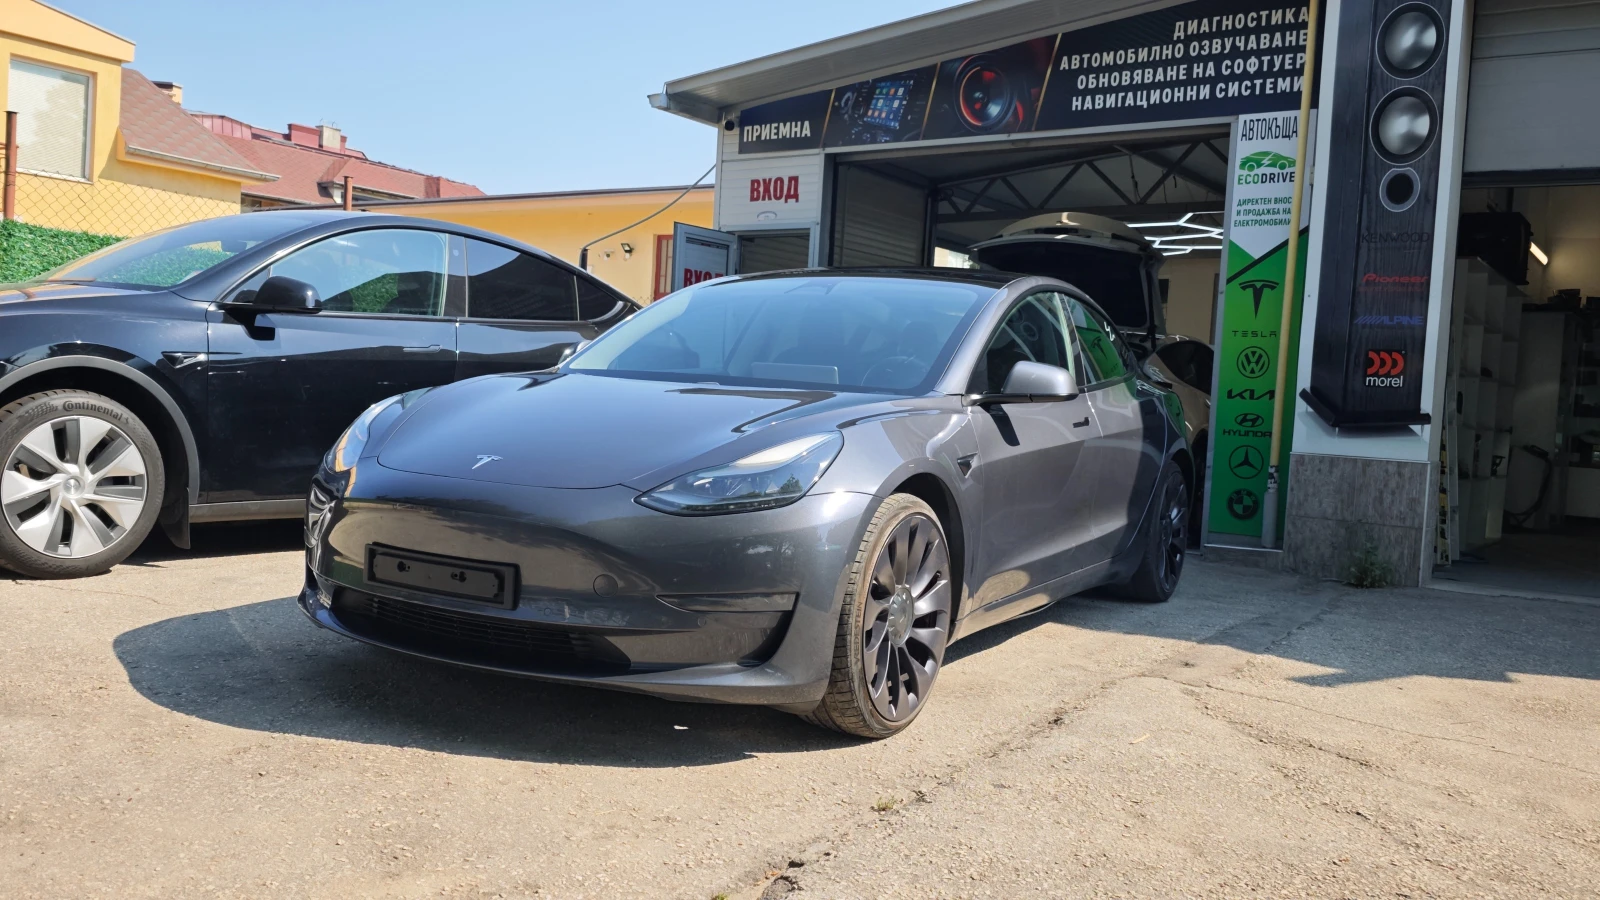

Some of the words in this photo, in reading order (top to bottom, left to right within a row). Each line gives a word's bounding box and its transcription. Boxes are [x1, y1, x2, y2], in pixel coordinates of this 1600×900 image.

[1173, 6, 1309, 40] ДИАГНОСТИКА
[1060, 43, 1184, 71] АВТОМОБИЛНО
[1189, 29, 1308, 57] ОЗВУЧАВАНЕ
[1077, 64, 1187, 90] ОБНОВЯВАНЕ
[1192, 62, 1215, 79] НА
[1221, 52, 1306, 76] СОФТУЕР
[1071, 84, 1210, 111] НАВИГАЦИОННИ
[1215, 75, 1305, 99] СИСТЕМИ
[743, 120, 811, 142] ПРИЕМНА
[1241, 115, 1298, 141] АВТОКЪЩА
[1237, 171, 1296, 185] ECODRIVE
[750, 175, 799, 203] ВХОД
[1236, 197, 1272, 207] ДИРЕКТЕН
[1273, 196, 1292, 205] ВНОС
[1243, 207, 1281, 217] ПРОДАЖБА
[1282, 207, 1291, 215] НА
[1361, 231, 1429, 243] KENWOOD
[1362, 273, 1428, 283] Pioneer
[1372, 315, 1424, 325] ALPINE
[1231, 330, 1277, 338] TESLA
[1365, 375, 1404, 387] morel
[62, 400, 123, 421] Continental
[1222, 428, 1273, 438] HYUNDA
